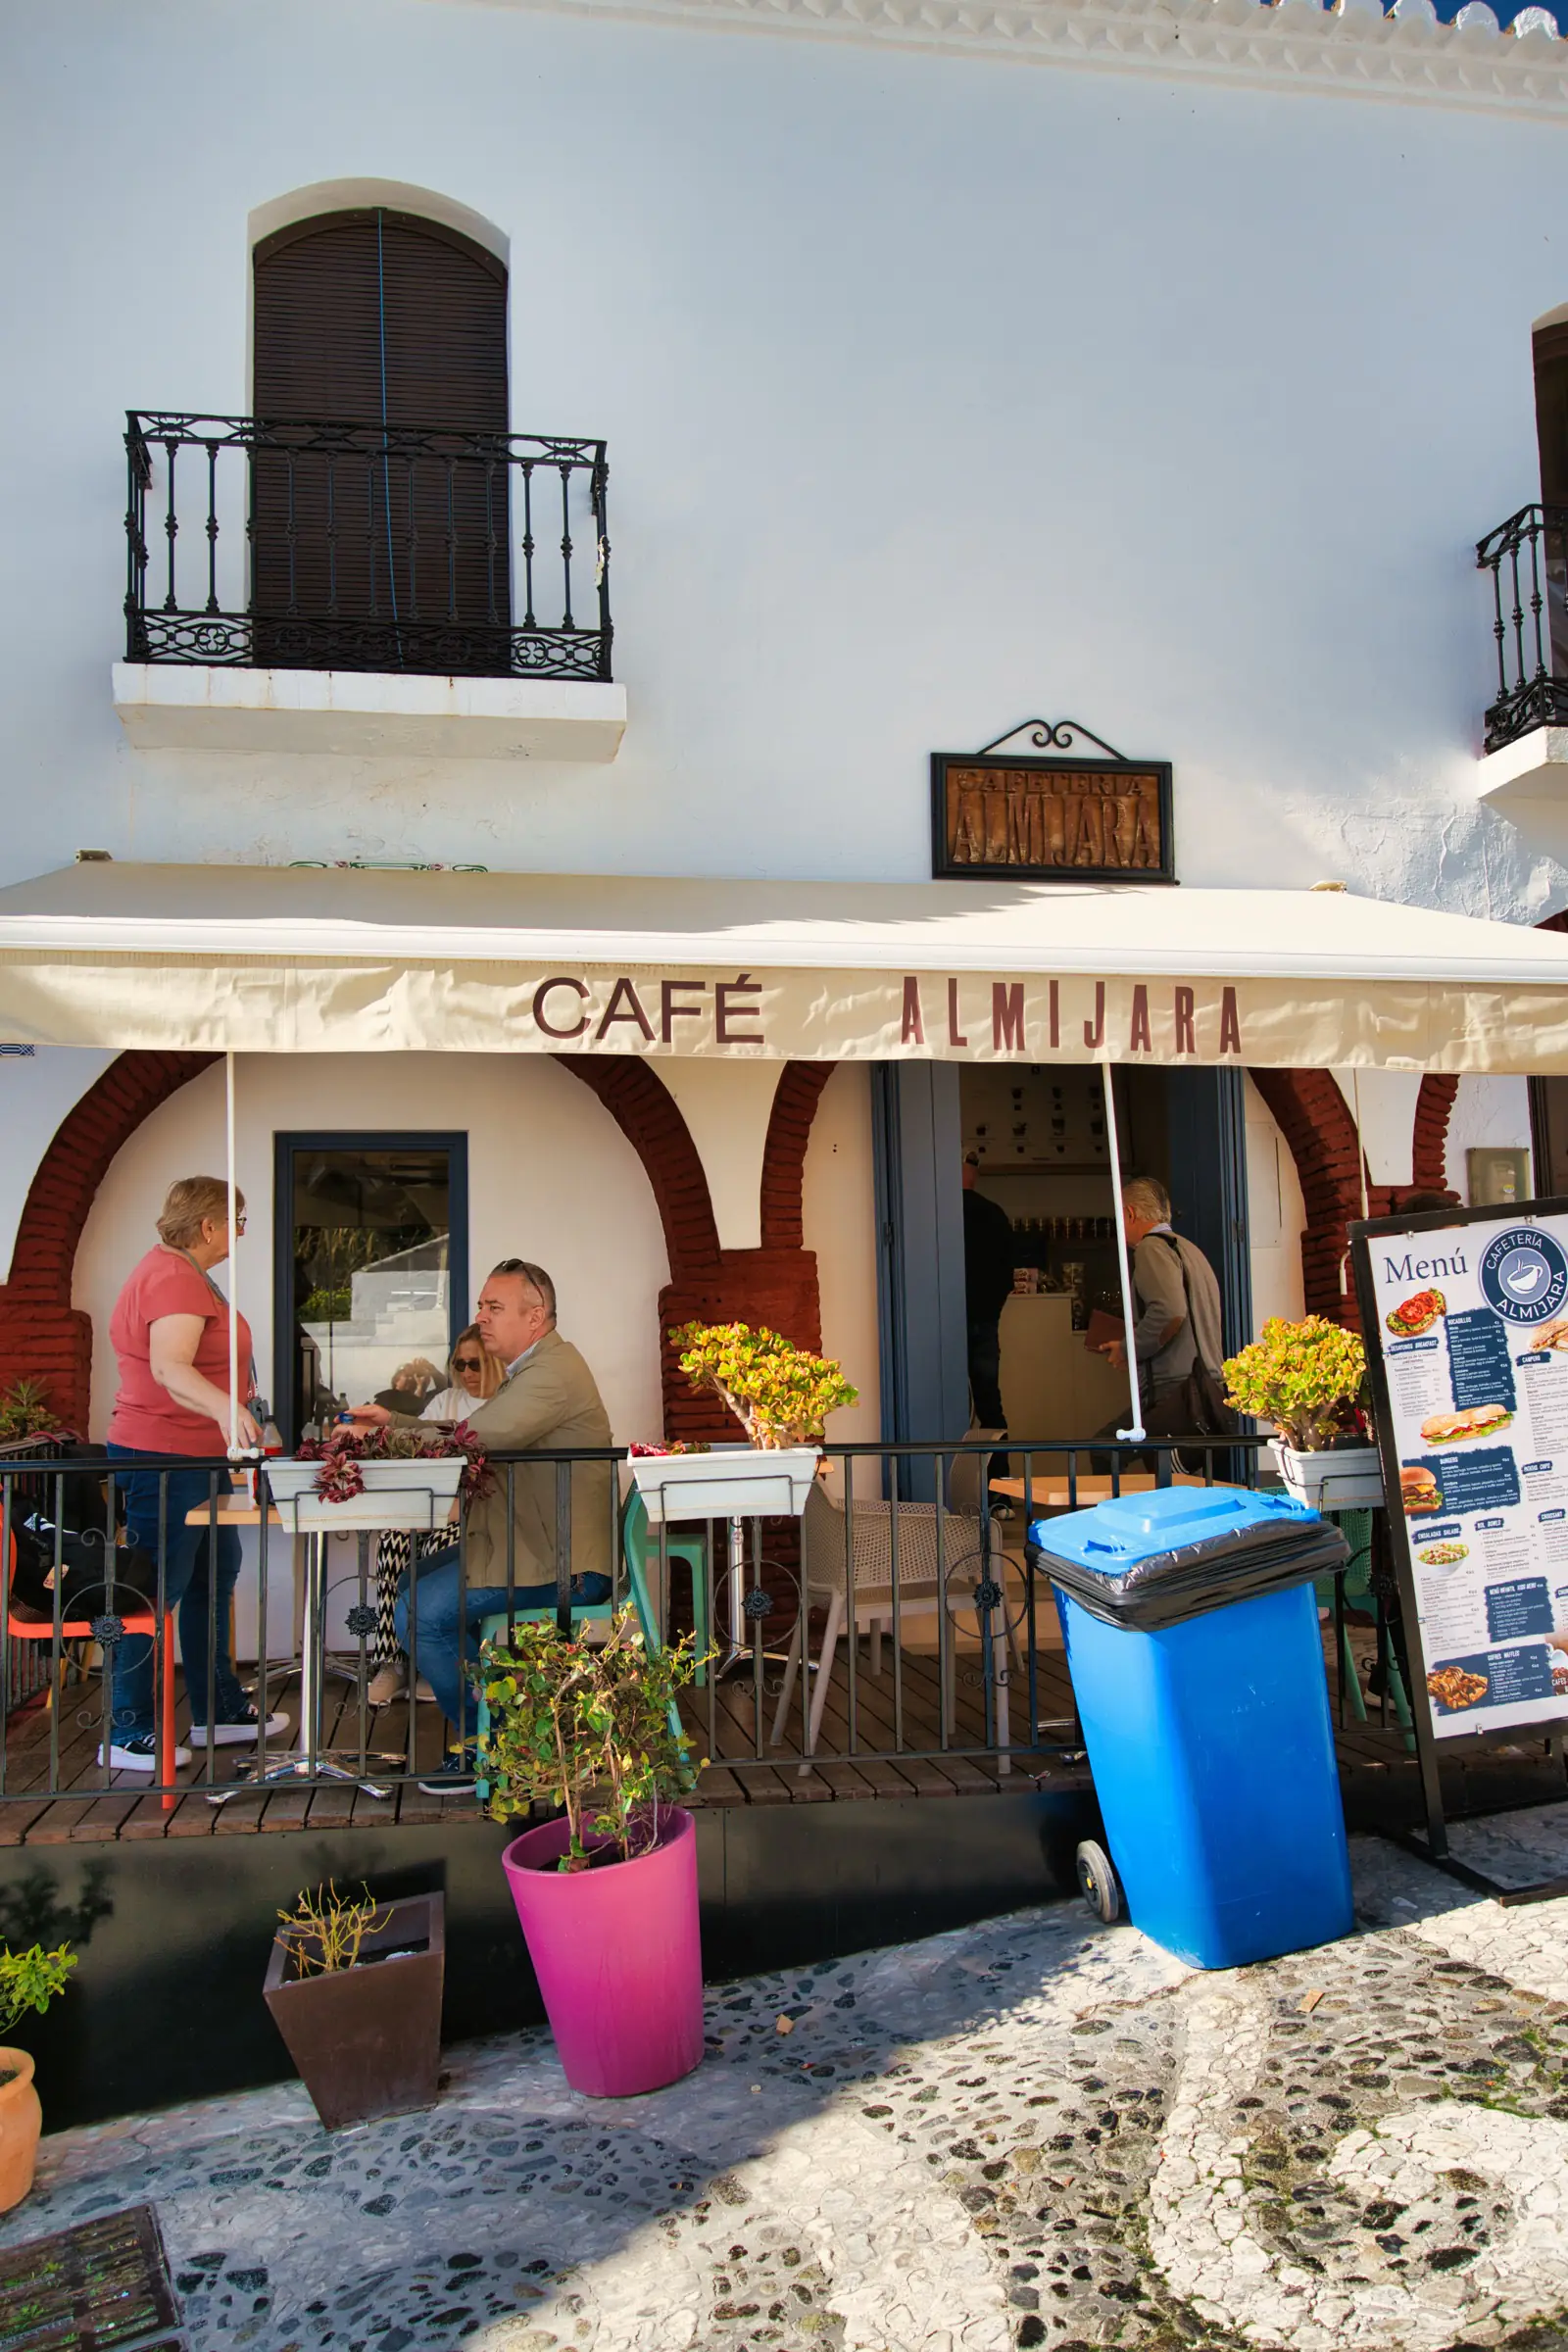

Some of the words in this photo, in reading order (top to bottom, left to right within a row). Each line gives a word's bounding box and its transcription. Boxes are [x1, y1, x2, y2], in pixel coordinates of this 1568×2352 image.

[957, 771, 1144, 796] CAFETERIA
[953, 791, 1161, 868] ALMIJARA
[531, 973, 765, 1045] CAFÉ
[901, 975, 1242, 1054] ALMIJARA
[1383, 1247, 1469, 1284] Menú
[1486, 1233, 1543, 1270] CAFETERÍA
[1495, 1270, 1565, 1319] ALMIJARA
